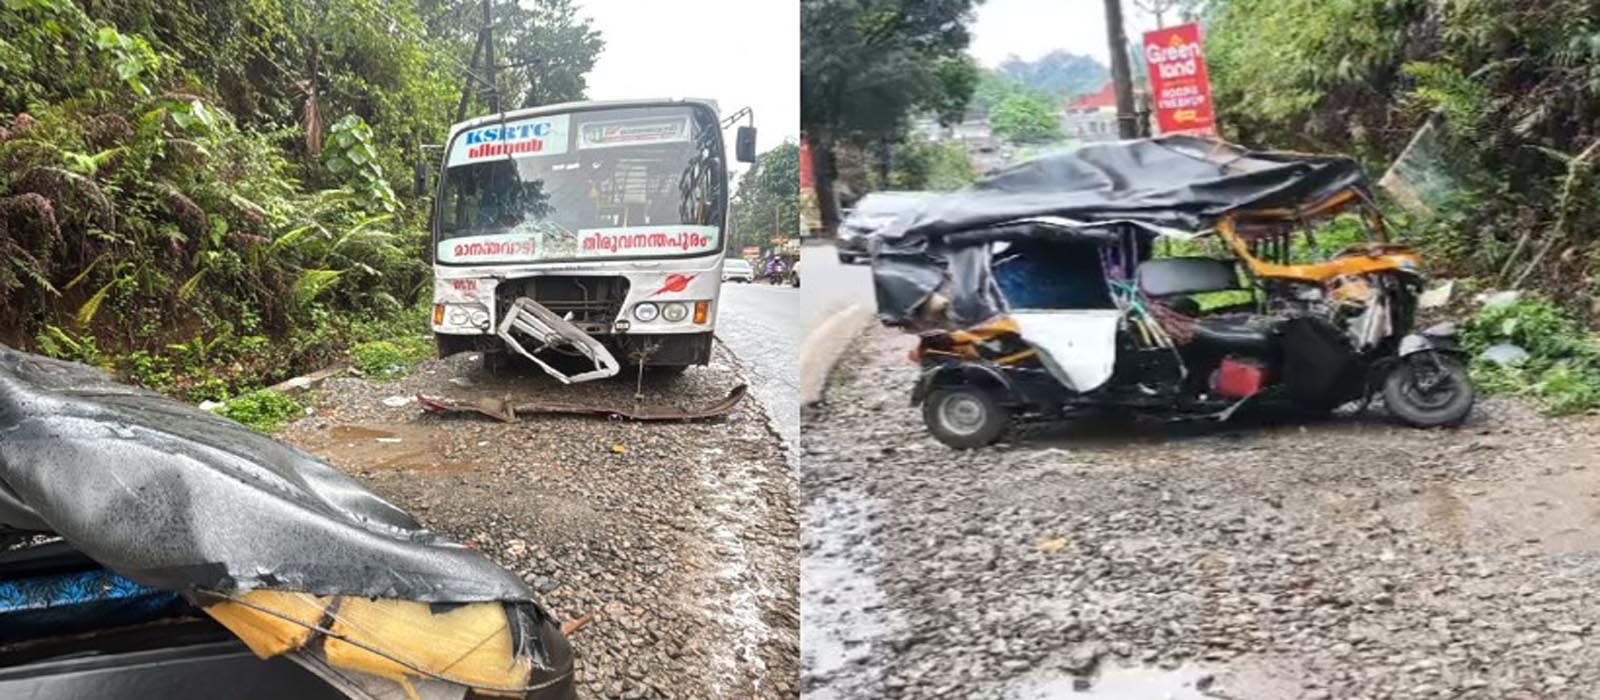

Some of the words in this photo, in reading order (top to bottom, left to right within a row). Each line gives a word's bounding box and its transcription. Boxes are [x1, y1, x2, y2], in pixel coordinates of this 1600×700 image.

[1147, 43, 1199, 64] Green
[1159, 60, 1197, 79] land
[466, 122, 552, 145] KSRTC
